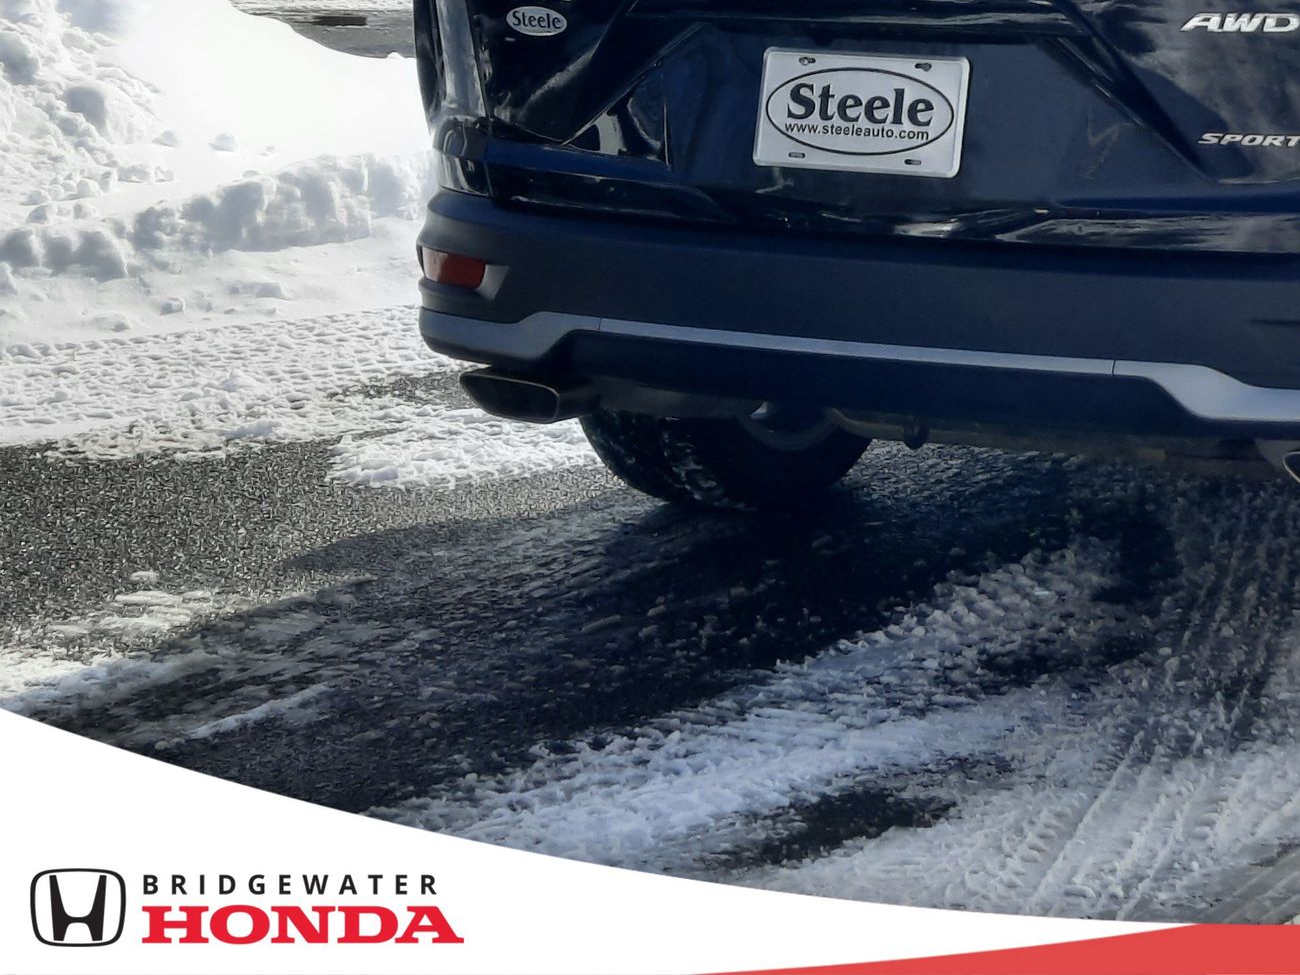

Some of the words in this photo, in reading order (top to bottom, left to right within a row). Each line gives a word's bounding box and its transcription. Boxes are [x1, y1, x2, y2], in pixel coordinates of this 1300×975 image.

[511, 10, 562, 30] Steele
[786, 82, 935, 127] Steele
[784, 122, 930, 141] www.steeleauto.com
